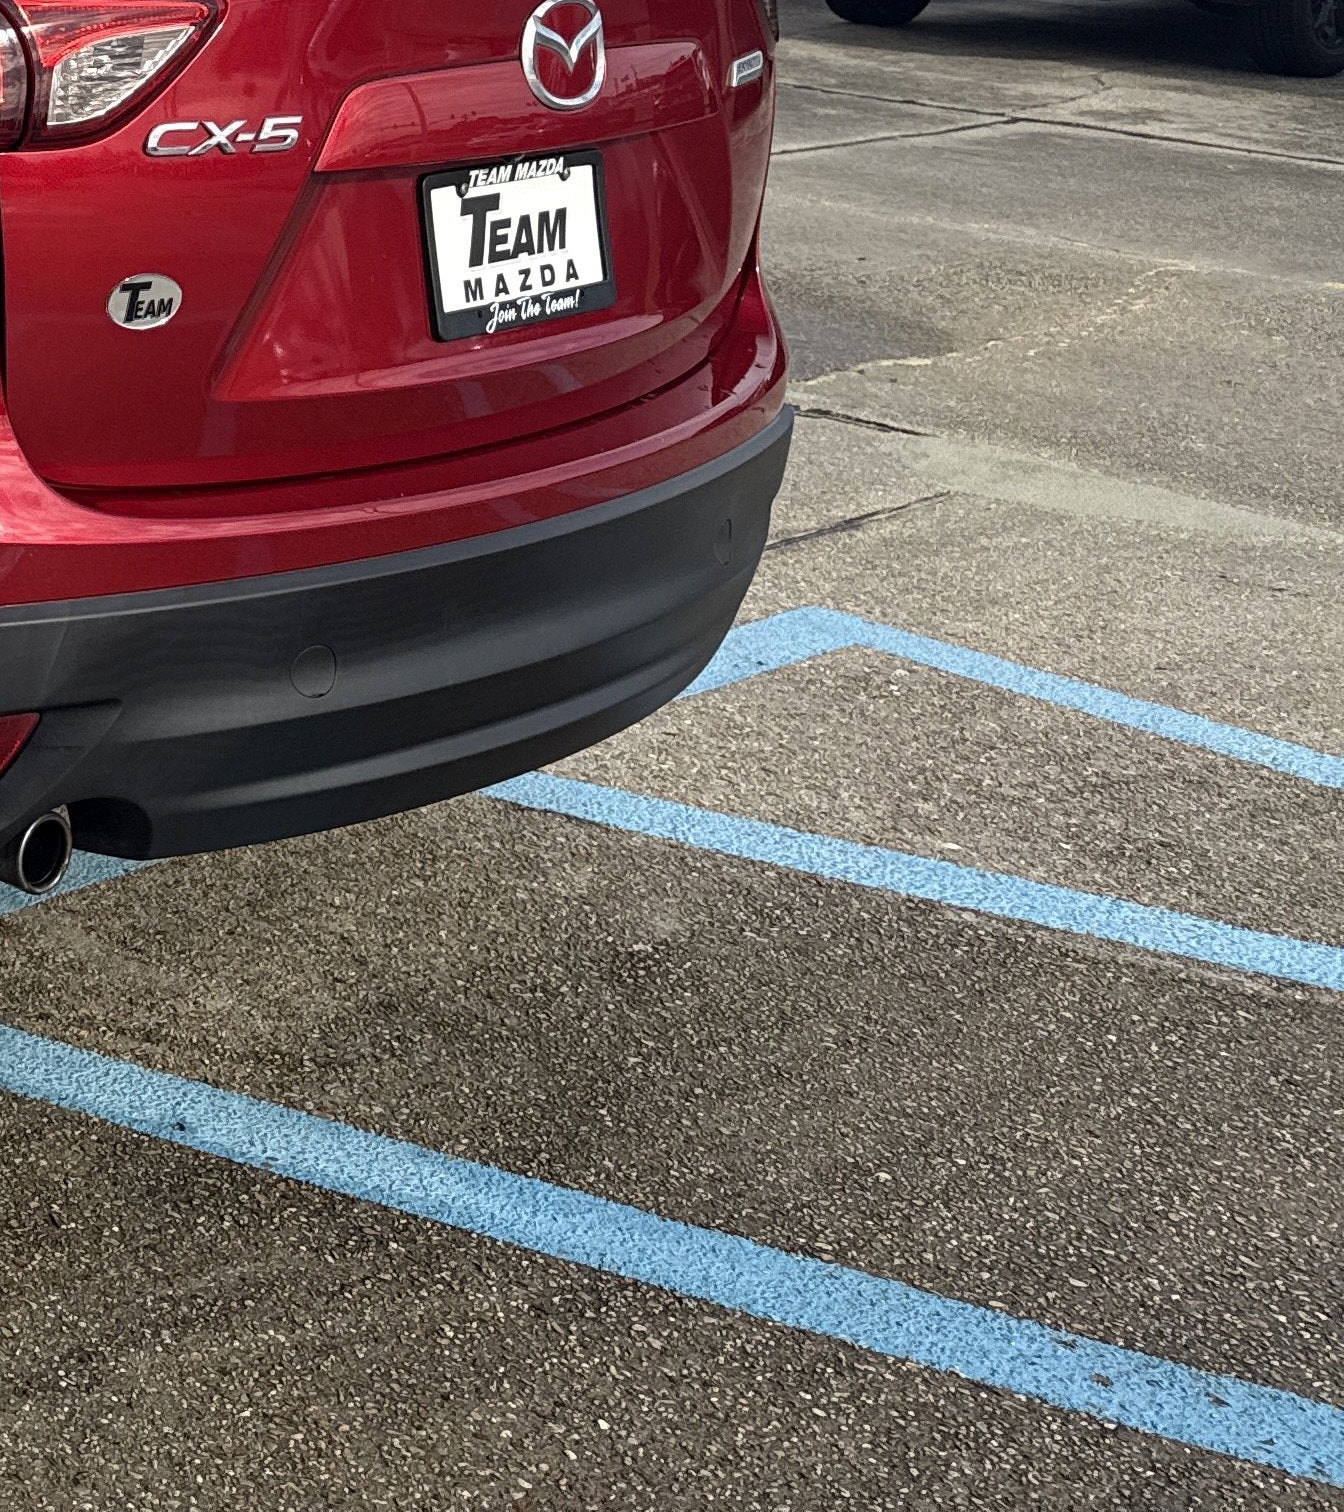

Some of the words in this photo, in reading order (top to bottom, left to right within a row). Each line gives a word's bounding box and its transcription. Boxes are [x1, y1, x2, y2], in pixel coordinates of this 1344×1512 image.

[143, 115, 303, 157] CX-5
[467, 164, 510, 188] TEAM
[514, 156, 564, 181] MAZDA
[460, 192, 567, 268] TEAM
[119, 281, 173, 323] TEAM
[463, 258, 579, 303] MAZDA
[485, 302, 517, 333] Join
[516, 295, 543, 321] The
[544, 288, 581, 315] Team!
